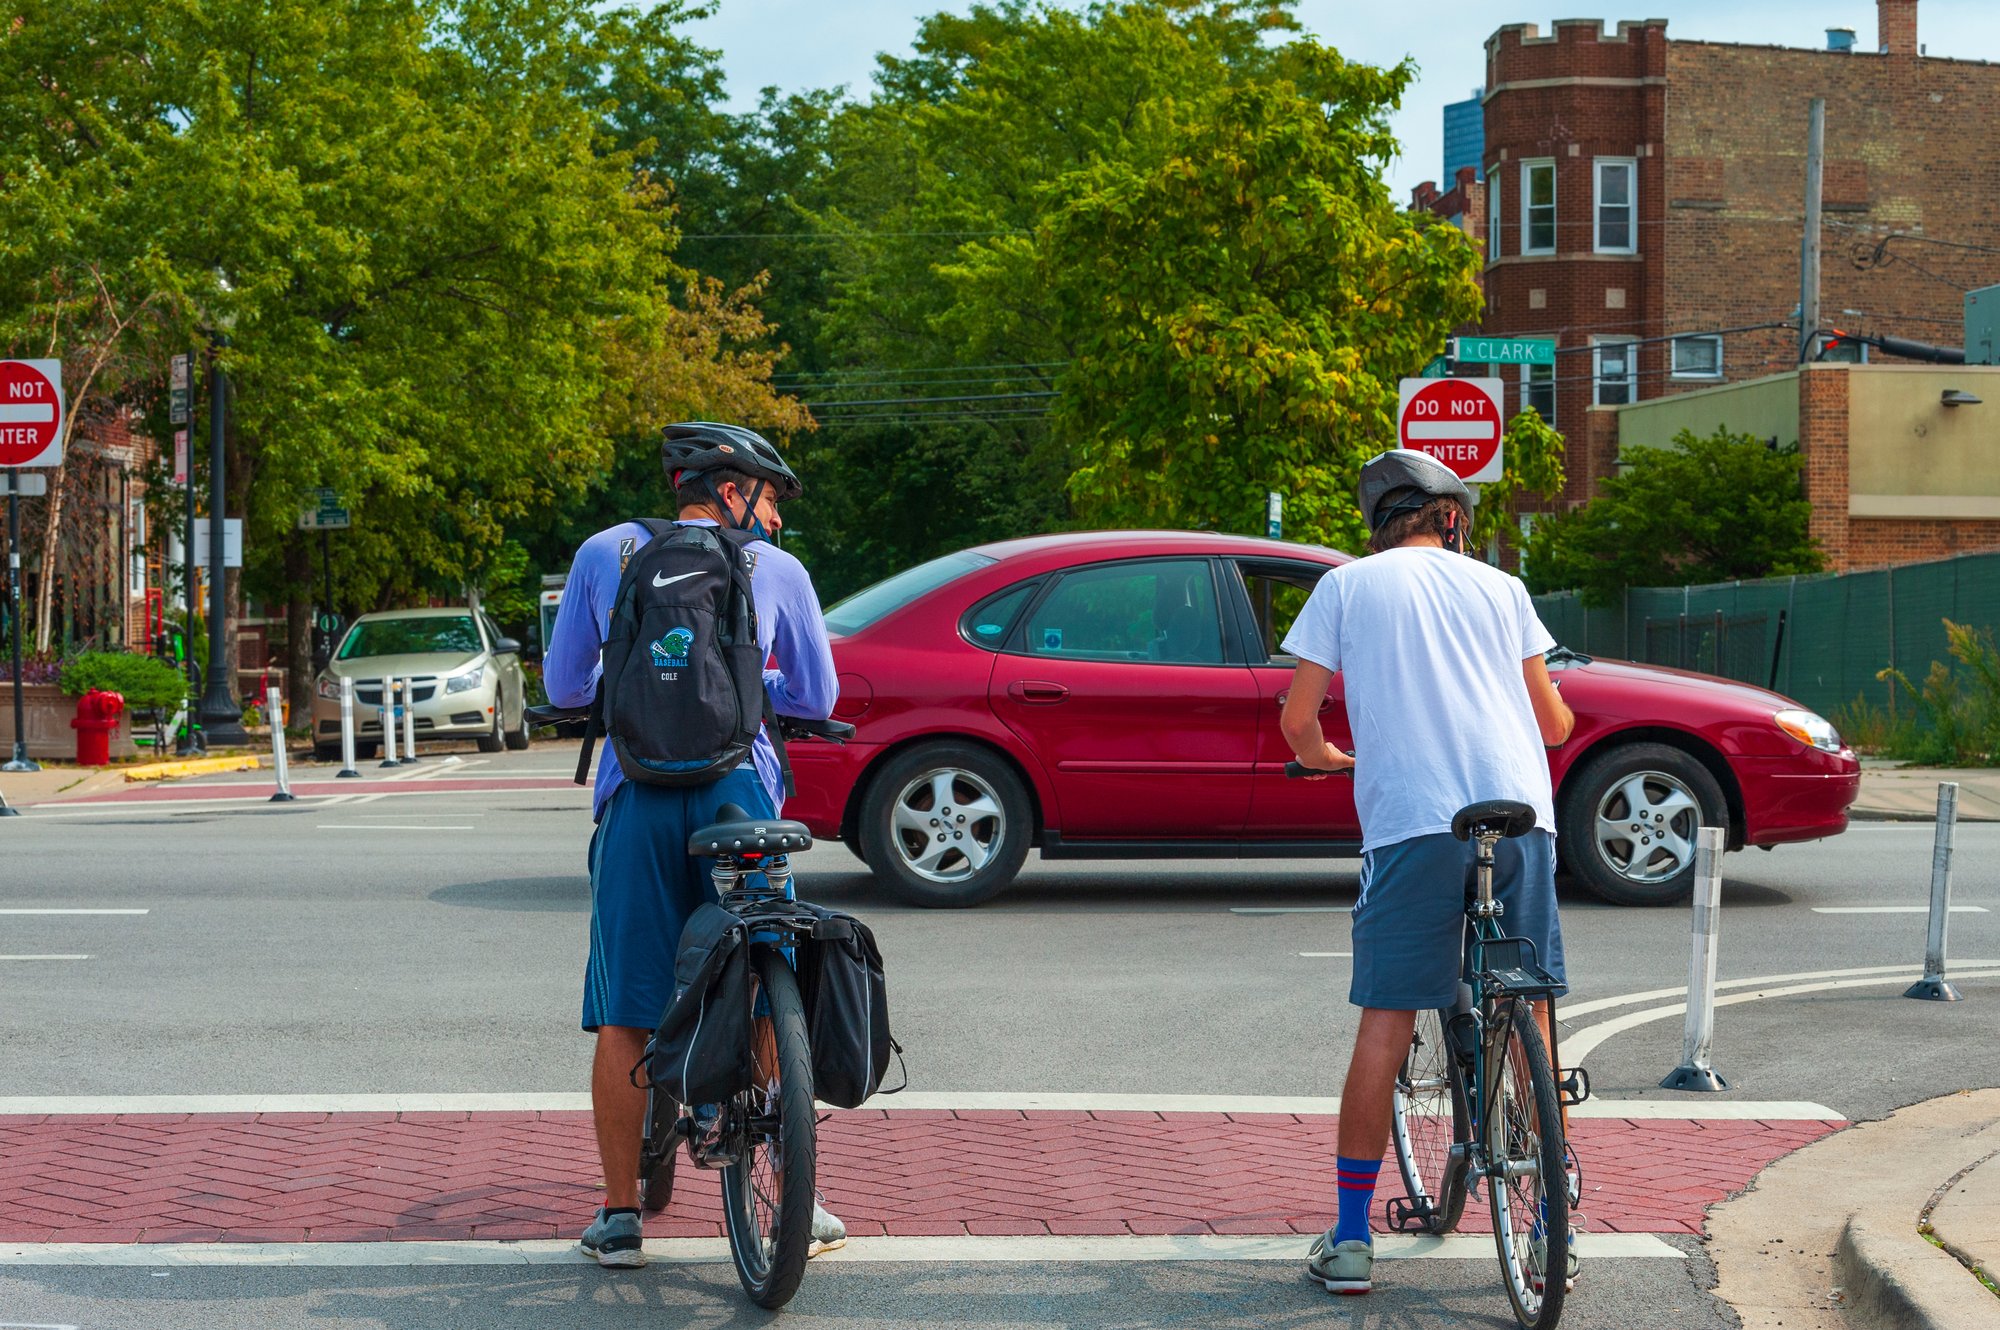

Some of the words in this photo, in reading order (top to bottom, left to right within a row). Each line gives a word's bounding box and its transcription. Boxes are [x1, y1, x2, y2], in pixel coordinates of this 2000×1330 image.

[1466, 346, 1473, 354] N
[1478, 342, 1535, 360] CLARK
[1538, 346, 1549, 358] ST
[9, 381, 45, 398] NOT
[1415, 399, 1439, 416] DO
[1450, 399, 1486, 416] NOT
[1422, 444, 1479, 460] ENTER
[654, 658, 689, 667] BASEBALL
[661, 672, 678, 681] COLE
